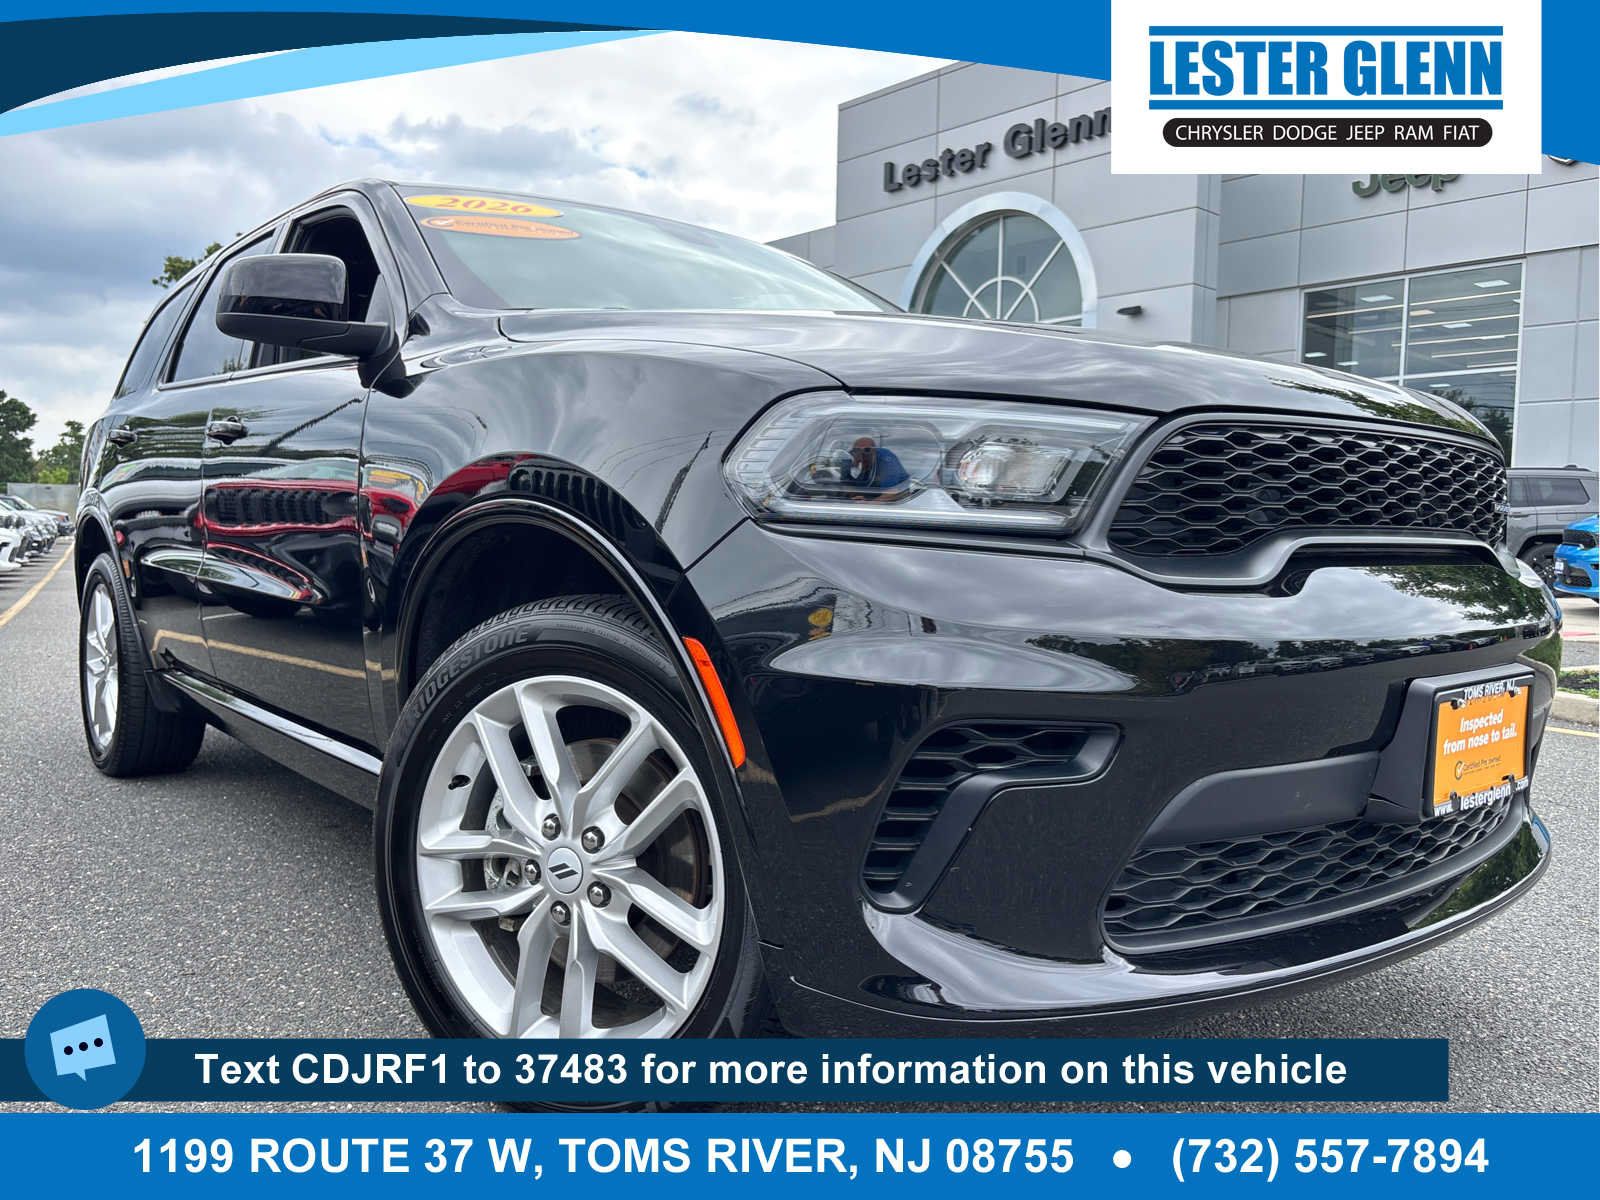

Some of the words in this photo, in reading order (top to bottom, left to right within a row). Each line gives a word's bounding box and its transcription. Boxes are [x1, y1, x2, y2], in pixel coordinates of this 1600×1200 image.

[883, 142, 992, 193] Lester
[1003, 106, 1111, 160] Glenn
[1460, 708, 1504, 734] Inspected
[1443, 738, 1466, 756] from
[1467, 732, 1489, 749] nose
[1491, 728, 1501, 743] to
[1501, 722, 1518, 740] tail.
[1459, 783, 1512, 811] lesterglenn
